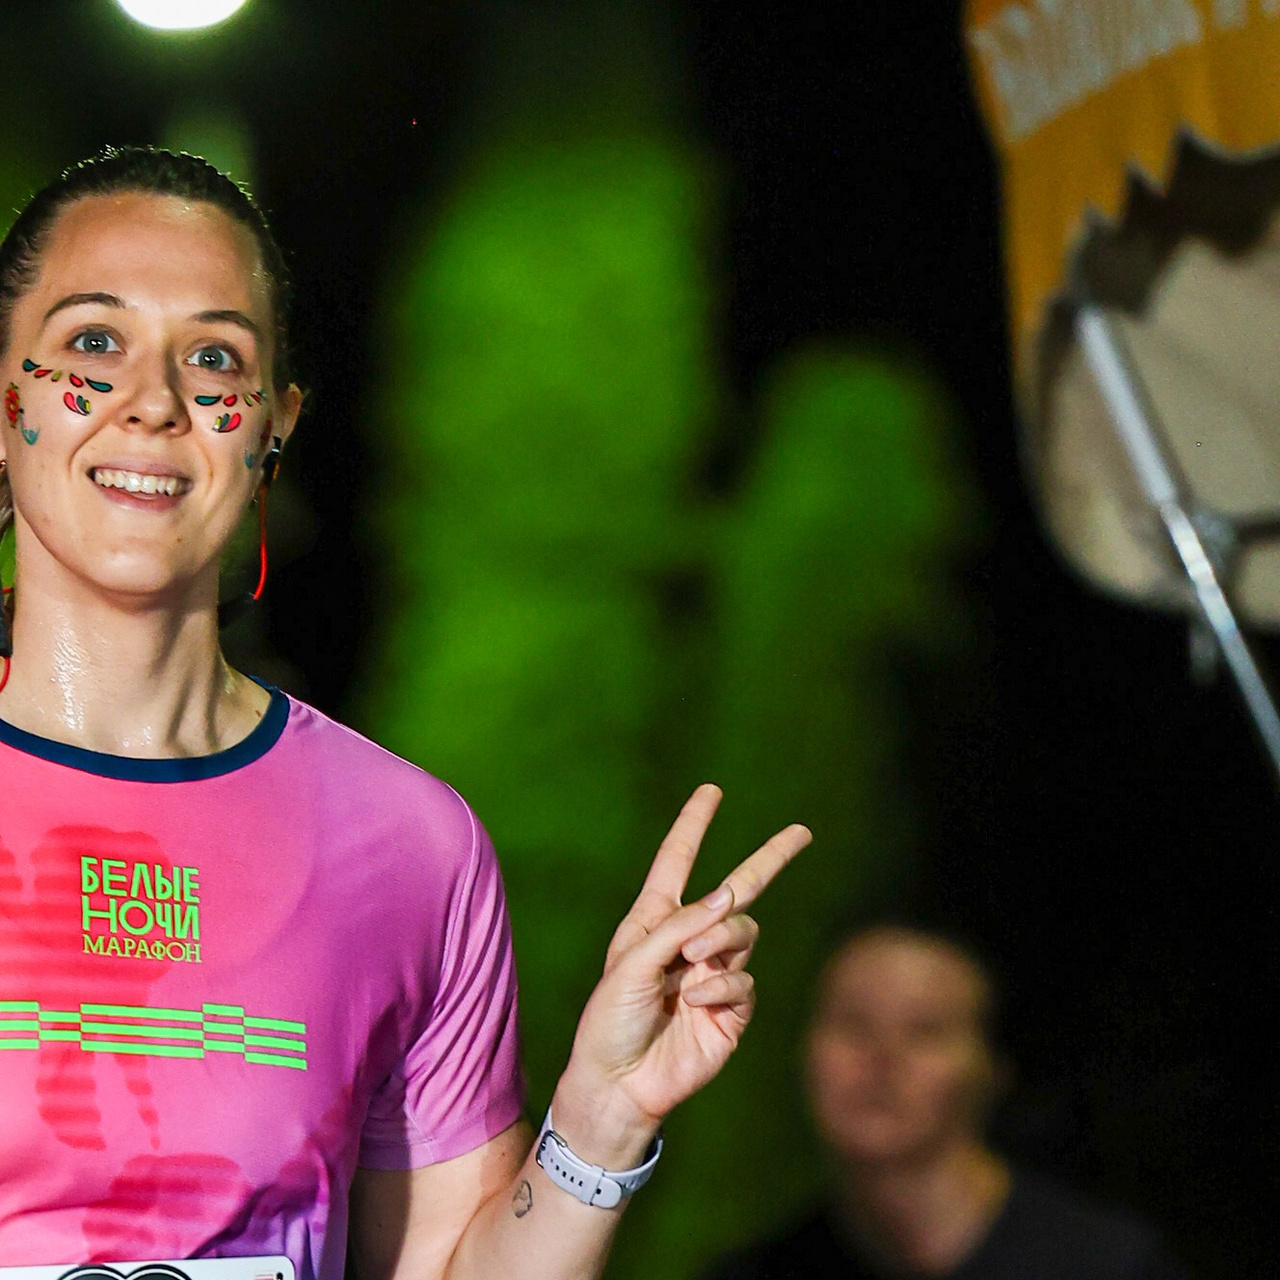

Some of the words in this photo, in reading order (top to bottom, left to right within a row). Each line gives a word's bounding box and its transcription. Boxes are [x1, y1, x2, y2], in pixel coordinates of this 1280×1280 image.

[80, 856, 201, 904] БЕЛЫЕ
[81, 894, 201, 941] НОЧИ
[82, 933, 203, 963] МАРАФОН
